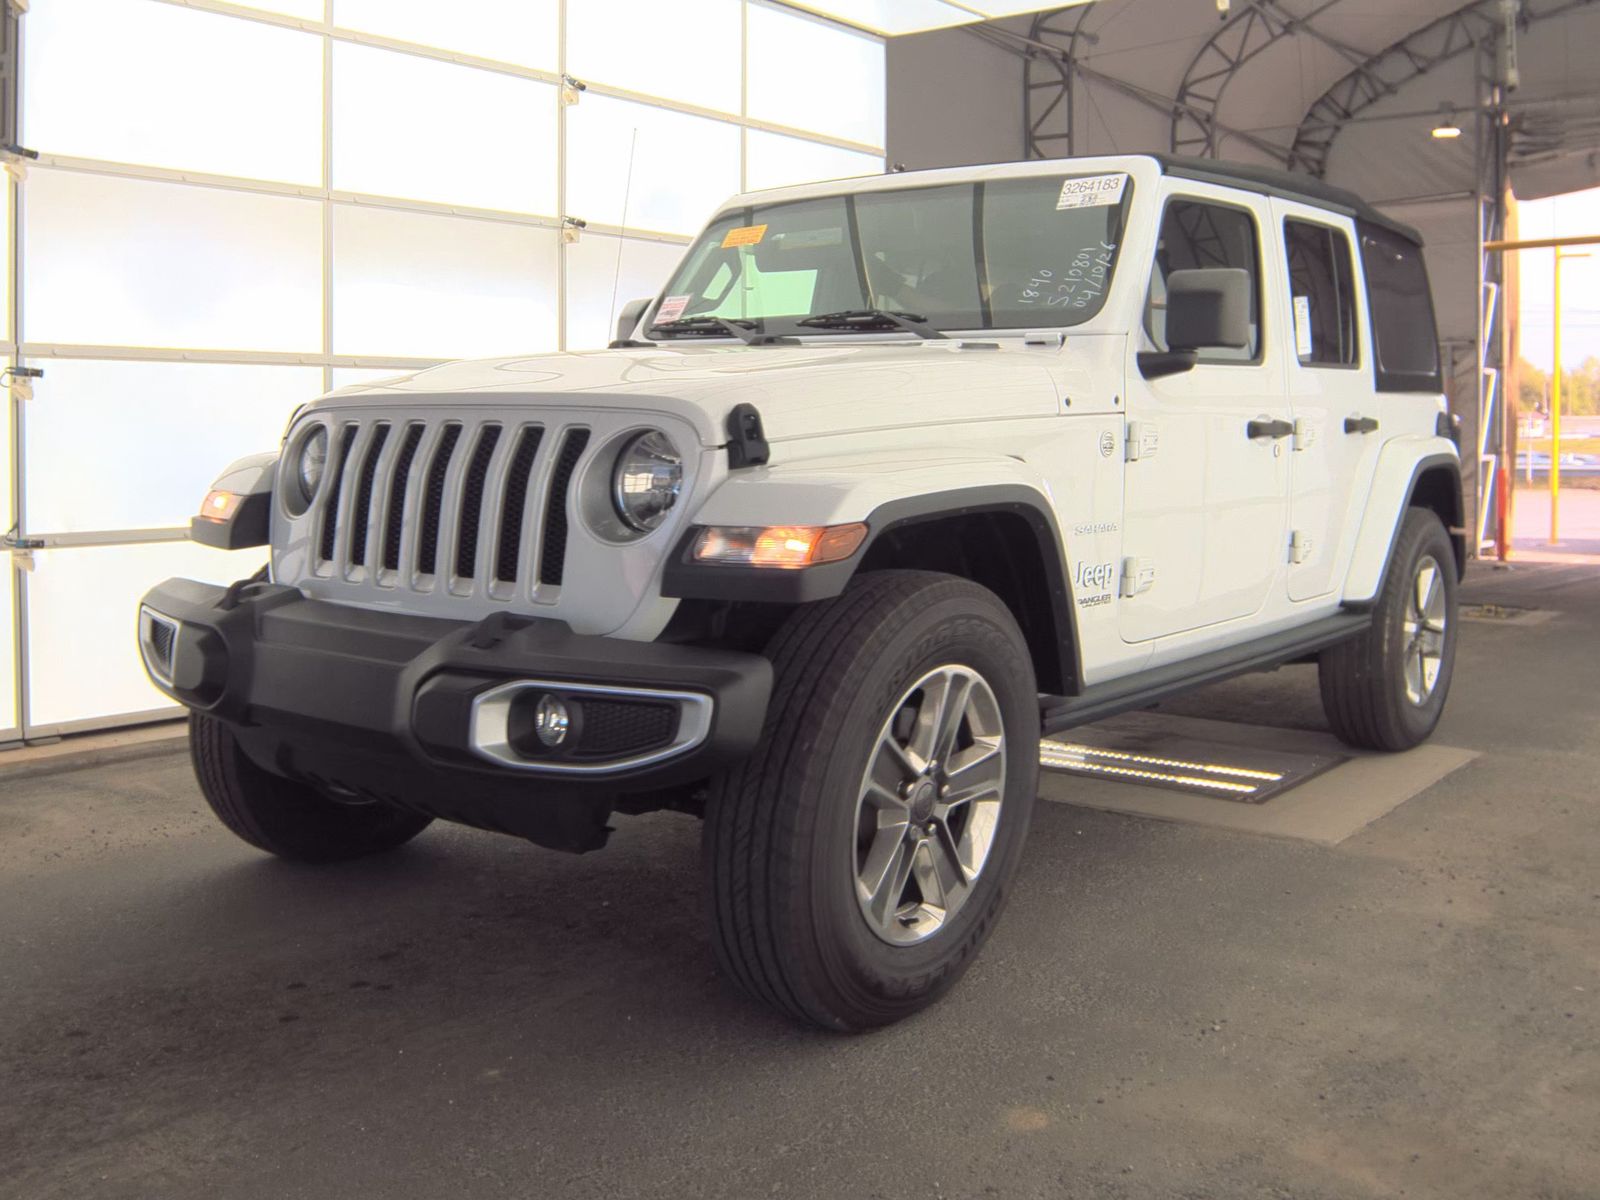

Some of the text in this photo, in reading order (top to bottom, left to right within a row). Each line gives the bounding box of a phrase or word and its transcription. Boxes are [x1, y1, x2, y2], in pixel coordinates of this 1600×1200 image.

[1062, 178, 1120, 195] 3264183
[1018, 269, 1053, 303] 1840
[1076, 560, 1113, 590] Jeep
